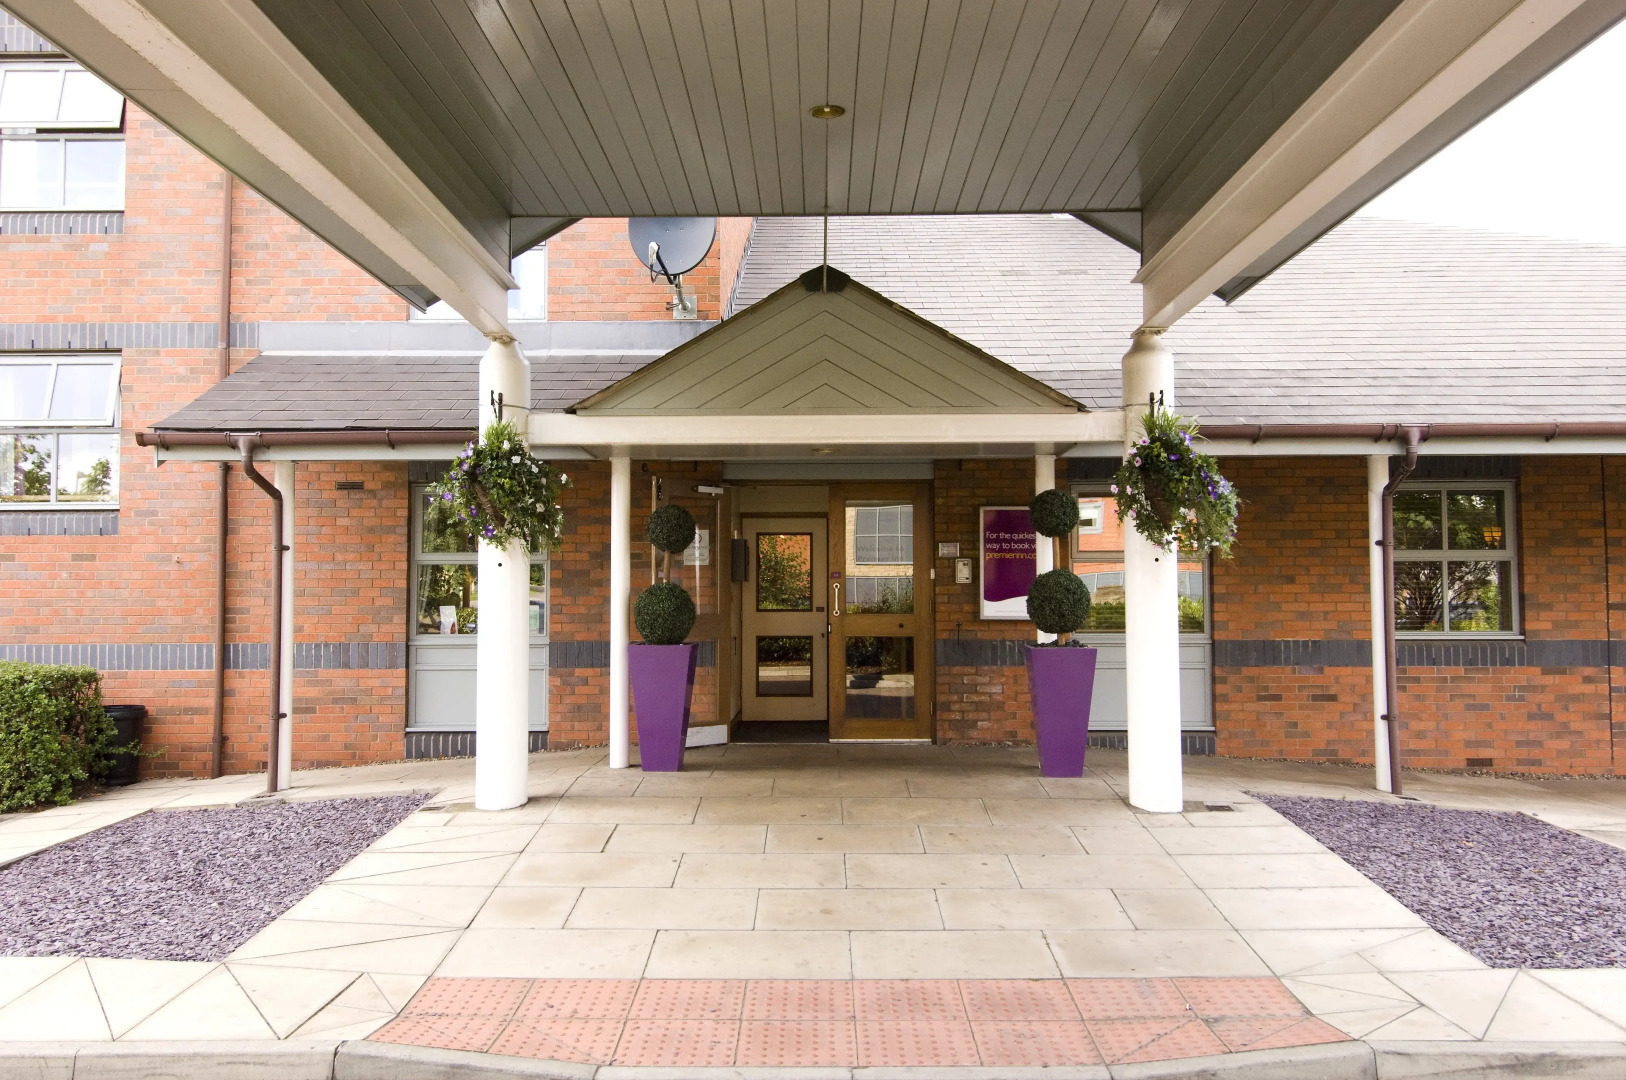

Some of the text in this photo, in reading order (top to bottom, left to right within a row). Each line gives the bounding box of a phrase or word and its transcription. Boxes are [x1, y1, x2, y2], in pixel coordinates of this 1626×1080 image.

[986, 531, 1036, 541] For the quickes
[986, 551, 1036, 560] premierinn.co
